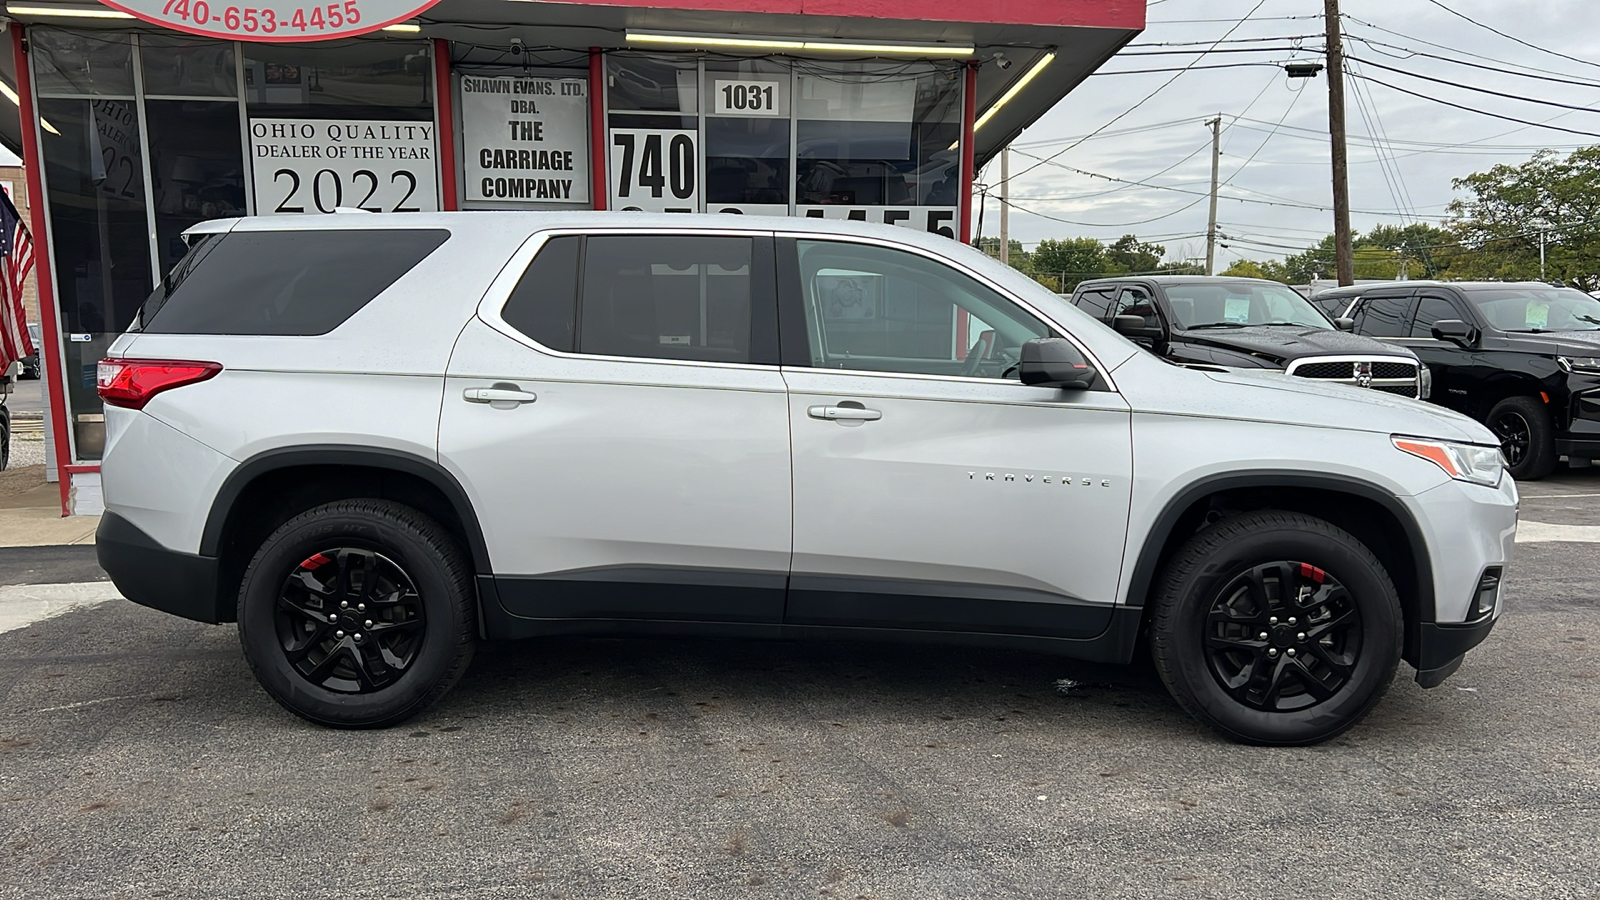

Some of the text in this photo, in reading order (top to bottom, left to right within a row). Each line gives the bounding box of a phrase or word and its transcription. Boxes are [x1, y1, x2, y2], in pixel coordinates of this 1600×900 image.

[464, 79, 585, 97] SHAWN EVANS. LTD.
[722, 84, 773, 110] 1031
[510, 100, 540, 114] DBA.
[252, 123, 432, 142] OHIO QUALITY
[508, 120, 544, 142] THE
[256, 144, 431, 160] DEALER OF THE YEAR
[479, 148, 574, 171] CARRIAGE
[613, 133, 695, 200] 740
[273, 168, 420, 214] 2022
[481, 177, 573, 199] COMPANY
[966, 471, 1111, 488] TRAVERSE
